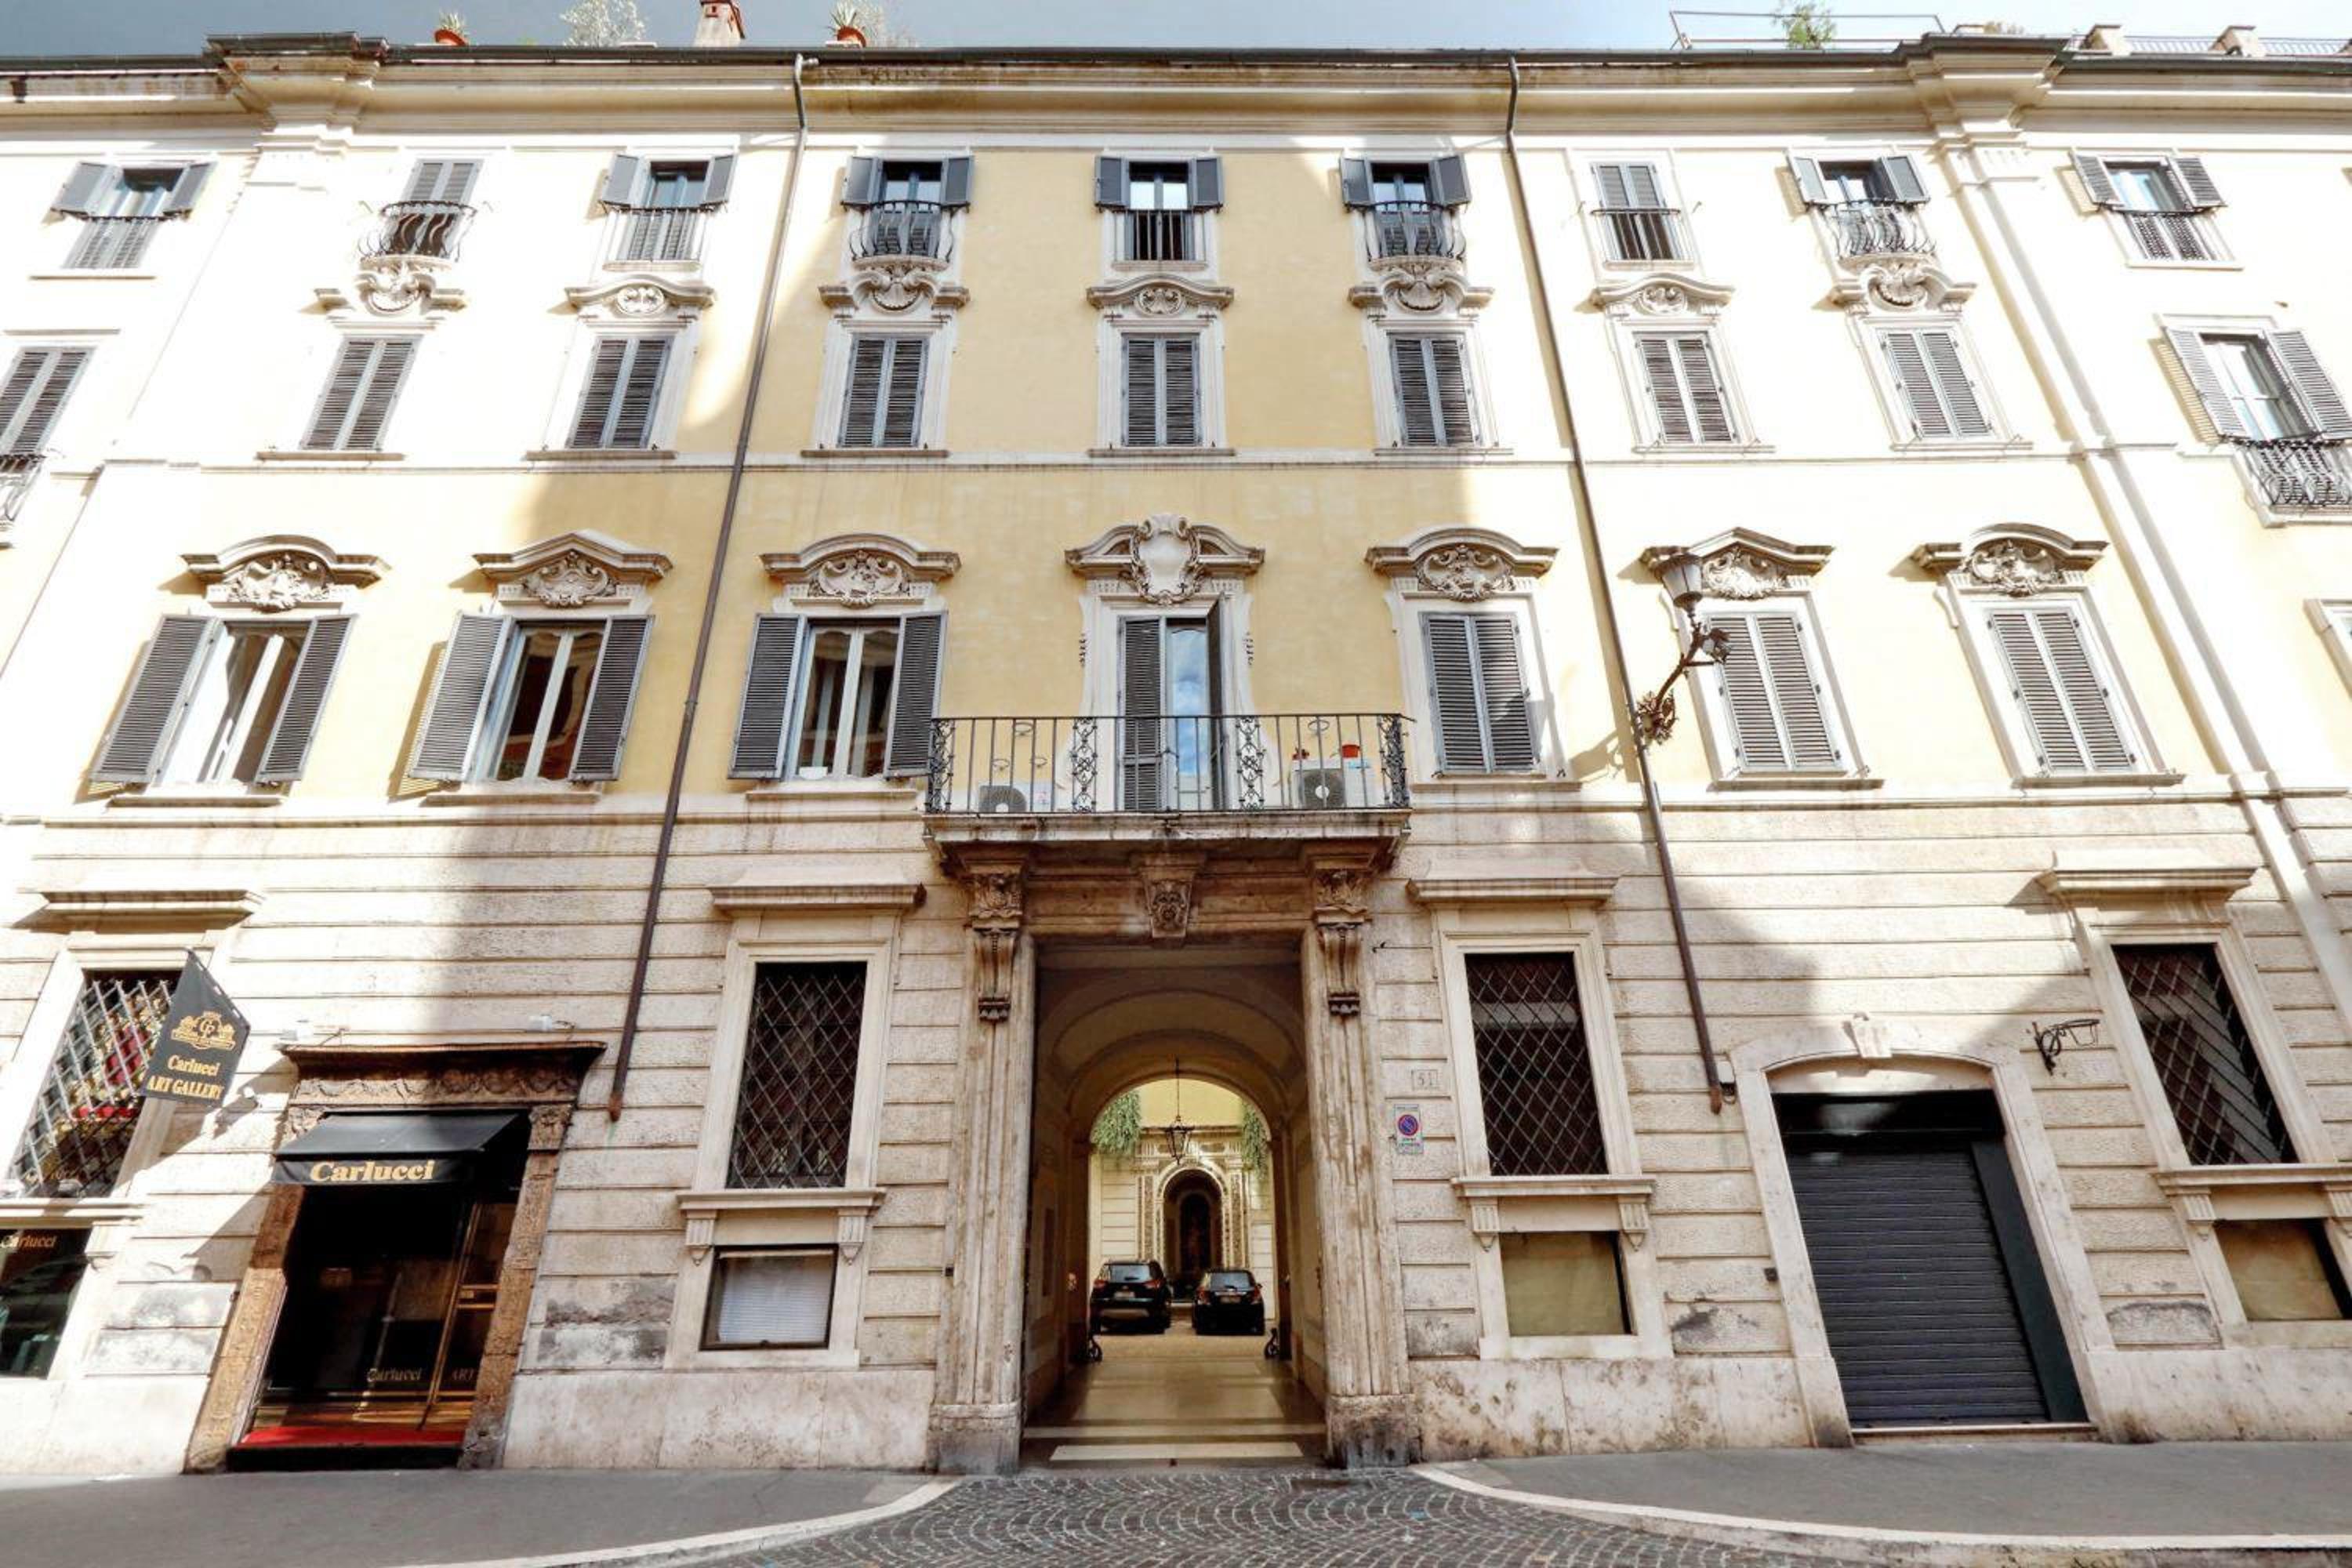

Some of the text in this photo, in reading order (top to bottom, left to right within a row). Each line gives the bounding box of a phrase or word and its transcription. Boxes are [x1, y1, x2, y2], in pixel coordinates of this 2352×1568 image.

[167, 1054, 221, 1076] Carlucci
[147, 1075, 225, 1100] ART GALLERY
[310, 1160, 436, 1182] Carlucci
[1, 1235, 57, 1248] Carlucci
